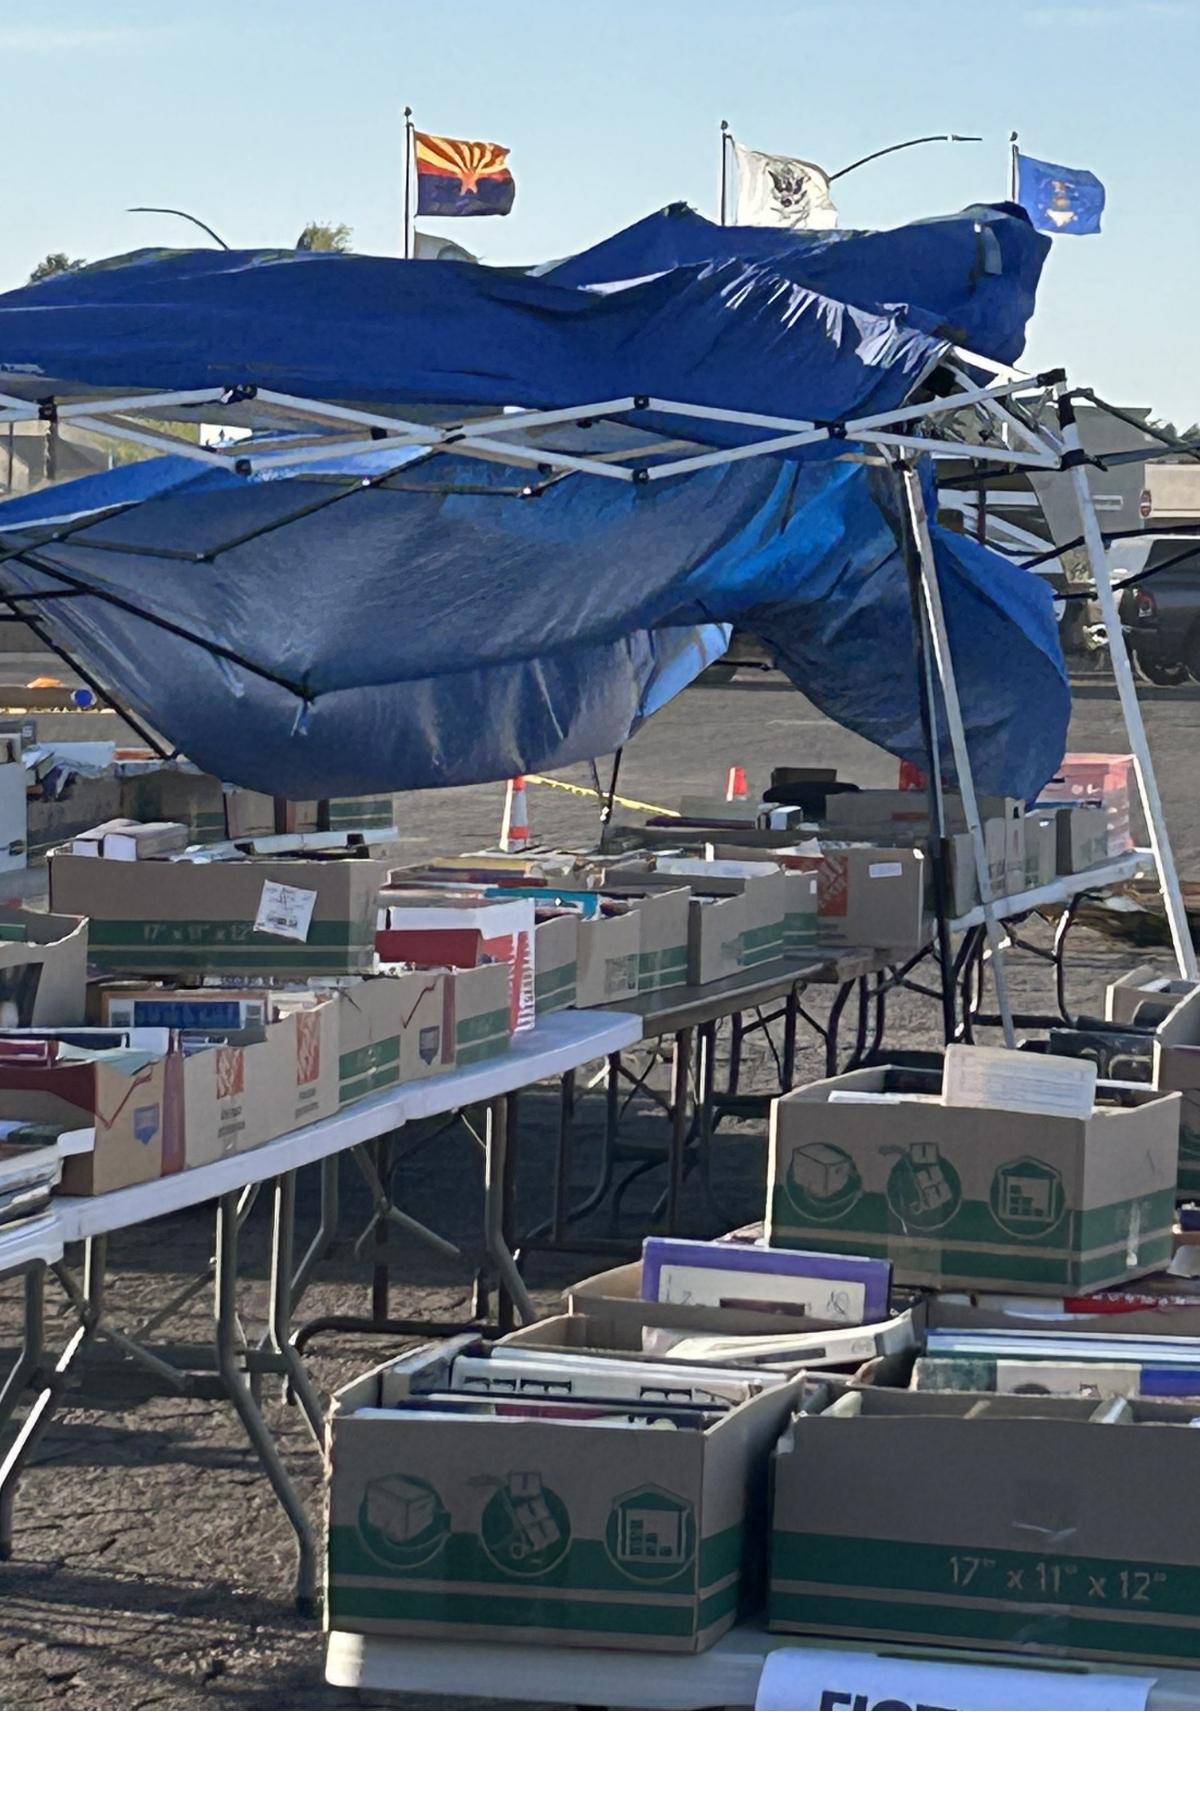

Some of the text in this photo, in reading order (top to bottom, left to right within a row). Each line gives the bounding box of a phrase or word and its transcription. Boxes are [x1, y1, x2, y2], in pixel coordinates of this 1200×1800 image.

[949, 1555, 1168, 1601] 17" x 11" x 12"
